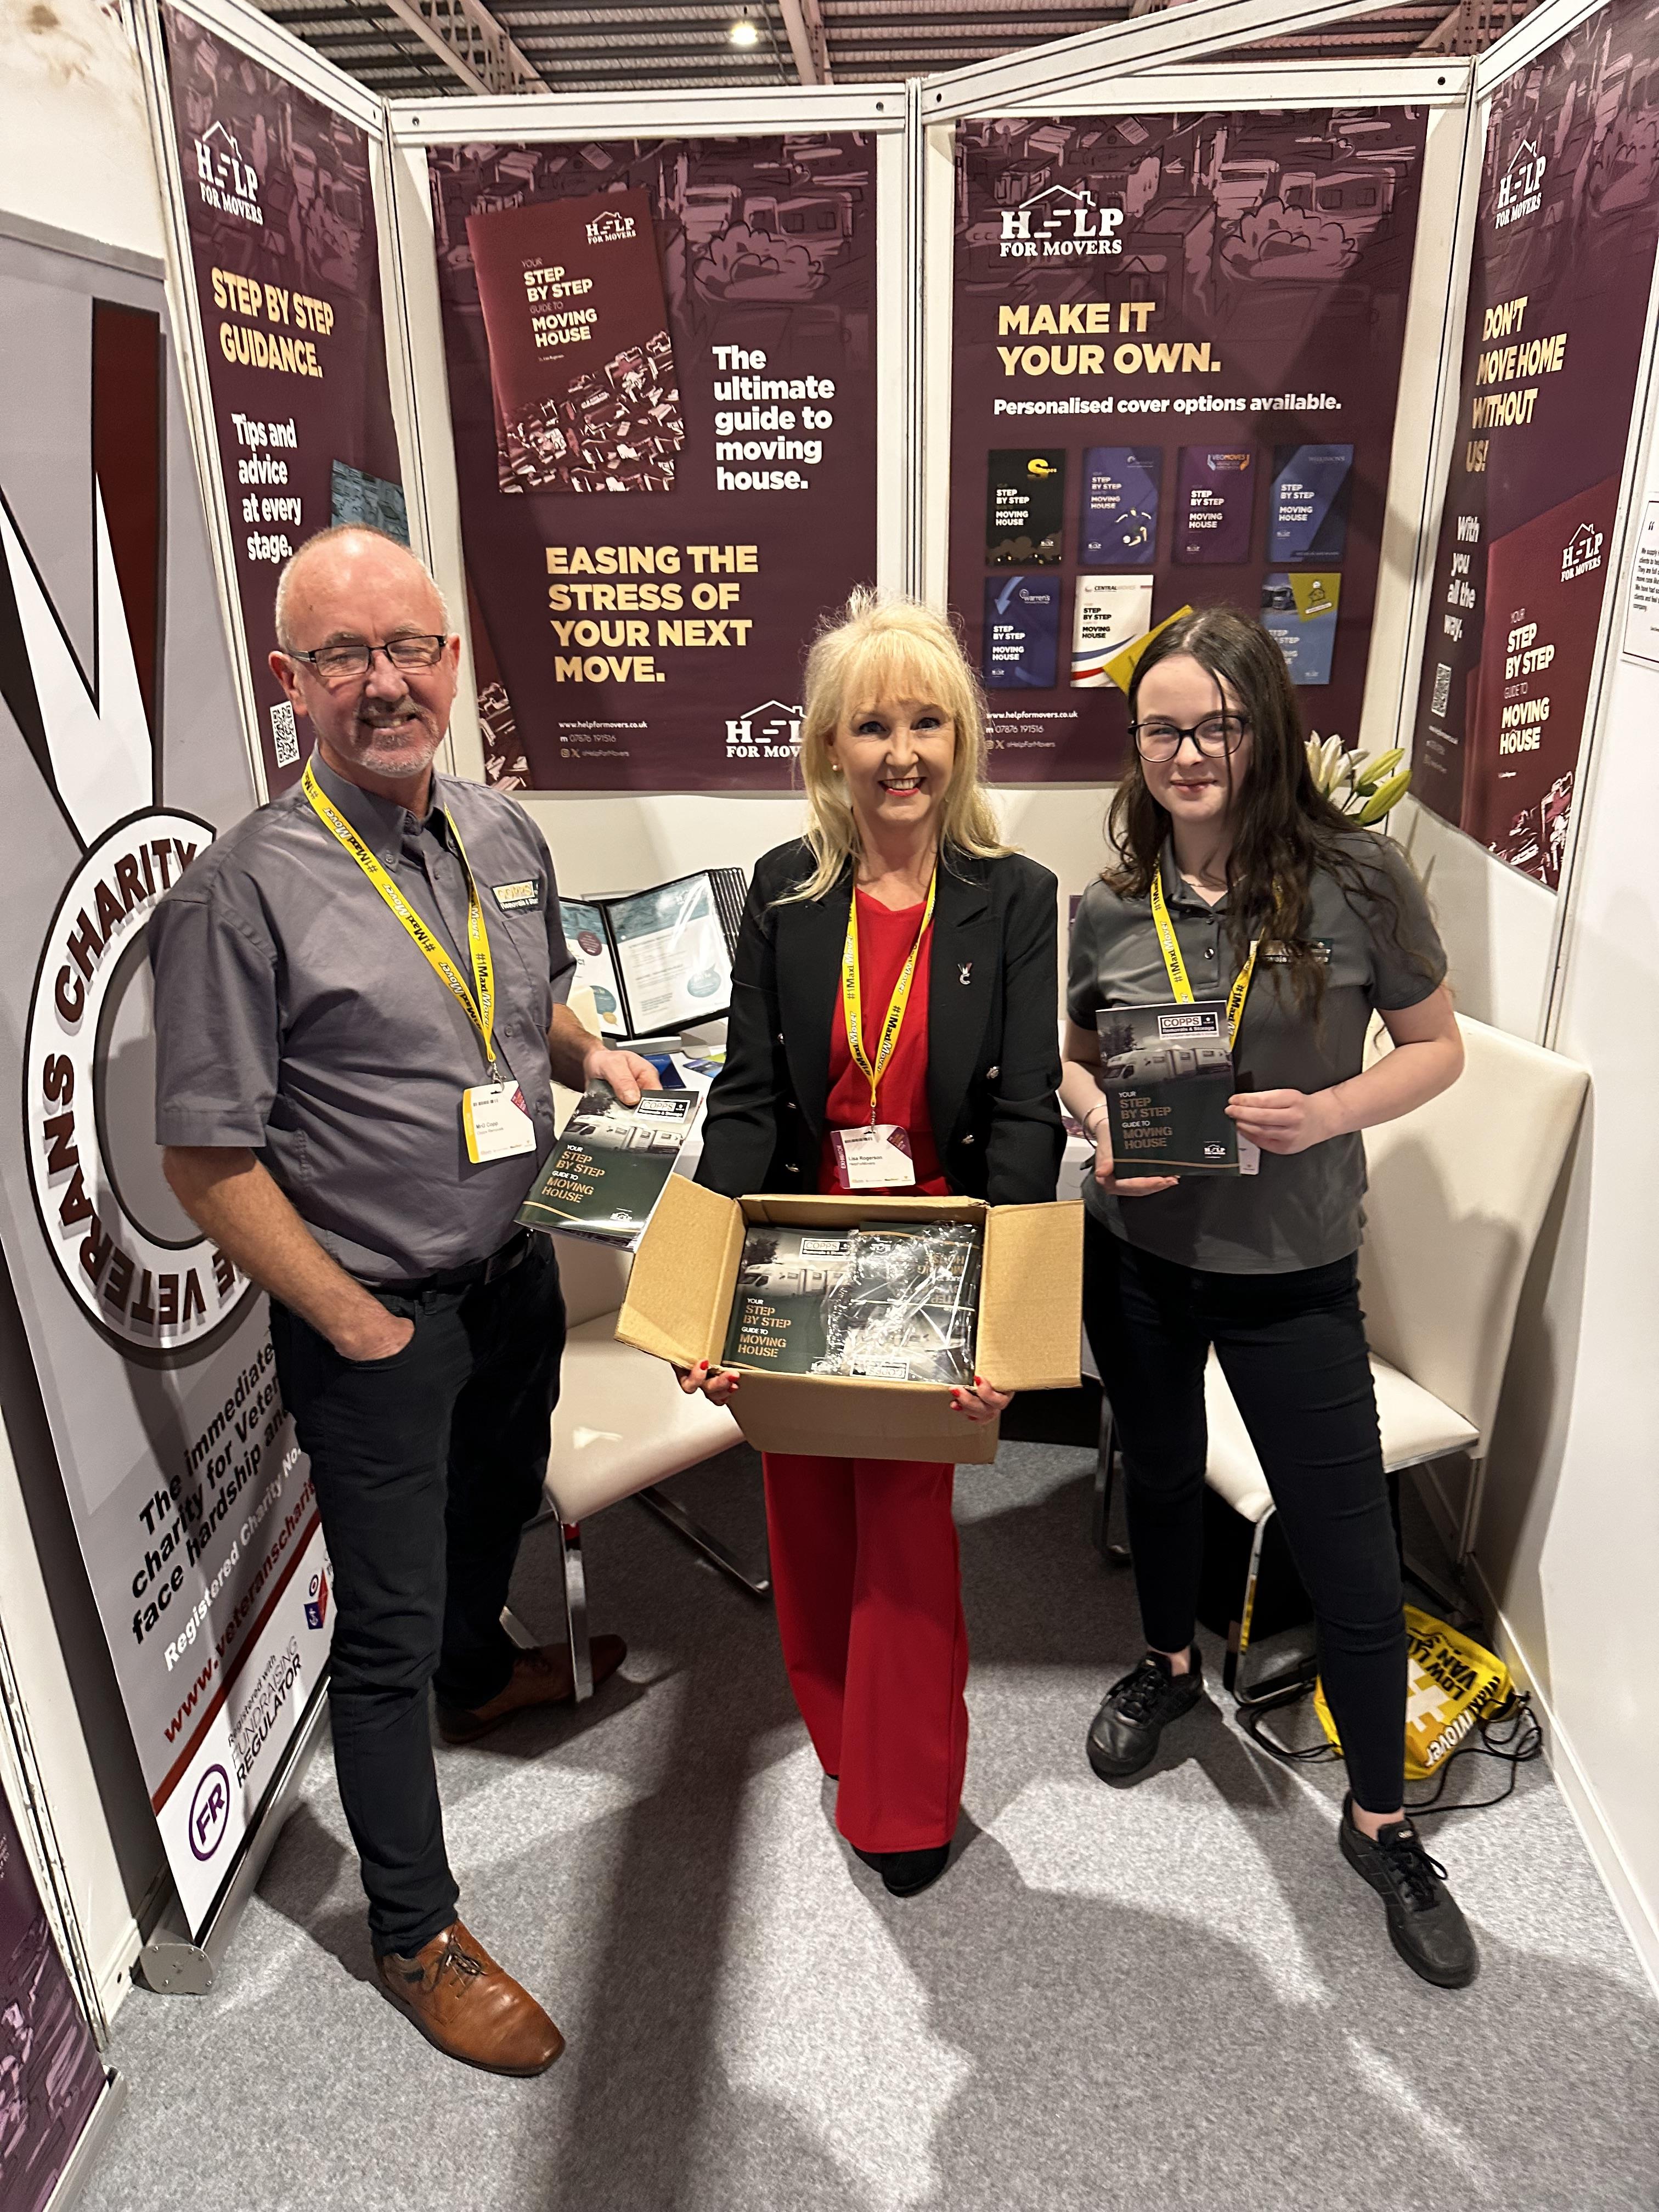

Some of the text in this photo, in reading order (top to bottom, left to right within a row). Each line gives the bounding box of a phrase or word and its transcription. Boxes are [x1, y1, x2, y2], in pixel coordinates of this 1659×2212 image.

[200, 183, 263, 225] FOR MOVERS
[1494, 193, 1542, 229] FOR MOVERS
[588, 229, 637, 245] FOR MOVERS
[1000, 239, 1123, 257] FOR MOVERS
[521, 257, 543, 268] YOUR
[523, 266, 566, 286] STEP
[212, 267, 334, 336] STEP BY STEP
[527, 278, 593, 302] BY STEP
[529, 301, 564, 314] GUIDE TO
[531, 308, 598, 332] MOVING
[998, 302, 1156, 336] MAKE IT
[1482, 296, 1528, 341] DON'T
[534, 325, 591, 348] HOUSE
[219, 321, 324, 379] GUIDANCE.
[712, 345, 767, 371] The
[996, 342, 1222, 376] YOUR OWN.
[1475, 332, 1567, 386] MOVE HOME
[713, 376, 836, 402] ultimate
[994, 393, 1342, 416] Personalised cover options available.
[1472, 387, 1538, 429] WITHOUT
[232, 413, 297, 450] Tips and
[715, 404, 833, 436] guide to
[715, 436, 823, 465] moving
[1465, 439, 1490, 472] US!
[238, 453, 289, 484] advice
[716, 466, 809, 492] house.
[996, 489, 1018, 497] STEP
[1008, 496, 1030, 504] STEP
[1190, 490, 1213, 498] STEP
[1203, 498, 1225, 506] STEP
[242, 493, 301, 526] at every
[996, 510, 1029, 519] MOVING
[1189, 513, 1223, 521] MOVING
[1189, 521, 1218, 529] HOUSE
[1457, 516, 1480, 543] With
[246, 531, 293, 564] stage.
[546, 544, 759, 575] EASING THE
[1451, 552, 1471, 577] you
[1560, 555, 1601, 583] FOR MOVERS
[549, 583, 740, 612] STRESS OF
[1447, 579, 1476, 610] all the
[551, 619, 753, 648] YOUR NEXT
[1443, 613, 1463, 642] way.
[1507, 622, 1537, 653] STEP
[554, 655, 666, 684] MOVE.
[1505, 644, 1555, 680] BY STEP
[558, 721, 648, 730] www.helpformovers.co.uk
[1501, 697, 1550, 729] MOVING
[995, 725, 1045, 733] 07876 191516
[1499, 726, 1542, 755] HOUSE
[726, 745, 802, 758] FOR MOV
[1163, 1017, 1200, 1028] COPPS
[43, 837, 207, 1325] VETERANS CHARITY
[642, 1100, 674, 1111] COPPS
[1120, 1097, 1152, 1109] STEP
[1120, 1107, 1172, 1120] BY STEP
[1122, 1126, 1173, 1139] MOVING
[1124, 1138, 1167, 1150] HOUSE
[556, 1160, 605, 1178] BY STEP
[561, 1151, 593, 1164] STEP
[546, 1177, 595, 1195] MOVING
[551, 1170, 570, 1179] GUIDE
[541, 1186, 584, 1203] HOUSE
[805, 1240, 838, 1250] COPPS
[743, 1314, 792, 1329] BY STEP
[746, 1304, 776, 1316] STEP
[740, 1334, 787, 1348] MOVING
[741, 1326, 759, 1334] GUIDE
[737, 1345, 780, 1358] HOUSE
[139, 1474, 182, 1536] The
[183, 1341, 275, 1478] immediate
[131, 1440, 234, 1599] charity for
[131, 1442, 262, 1646] face hardship
[165, 1541, 240, 1671] Registered
[239, 1475, 283, 1546] Charity
[1426, 1661, 1466, 1701] LOW
[1436, 1647, 1479, 1691] VAN
[228, 1678, 262, 1748] Registered
[231, 1635, 298, 1769] FUNDRAISING
[236, 1653, 302, 1789] REGULATOR
